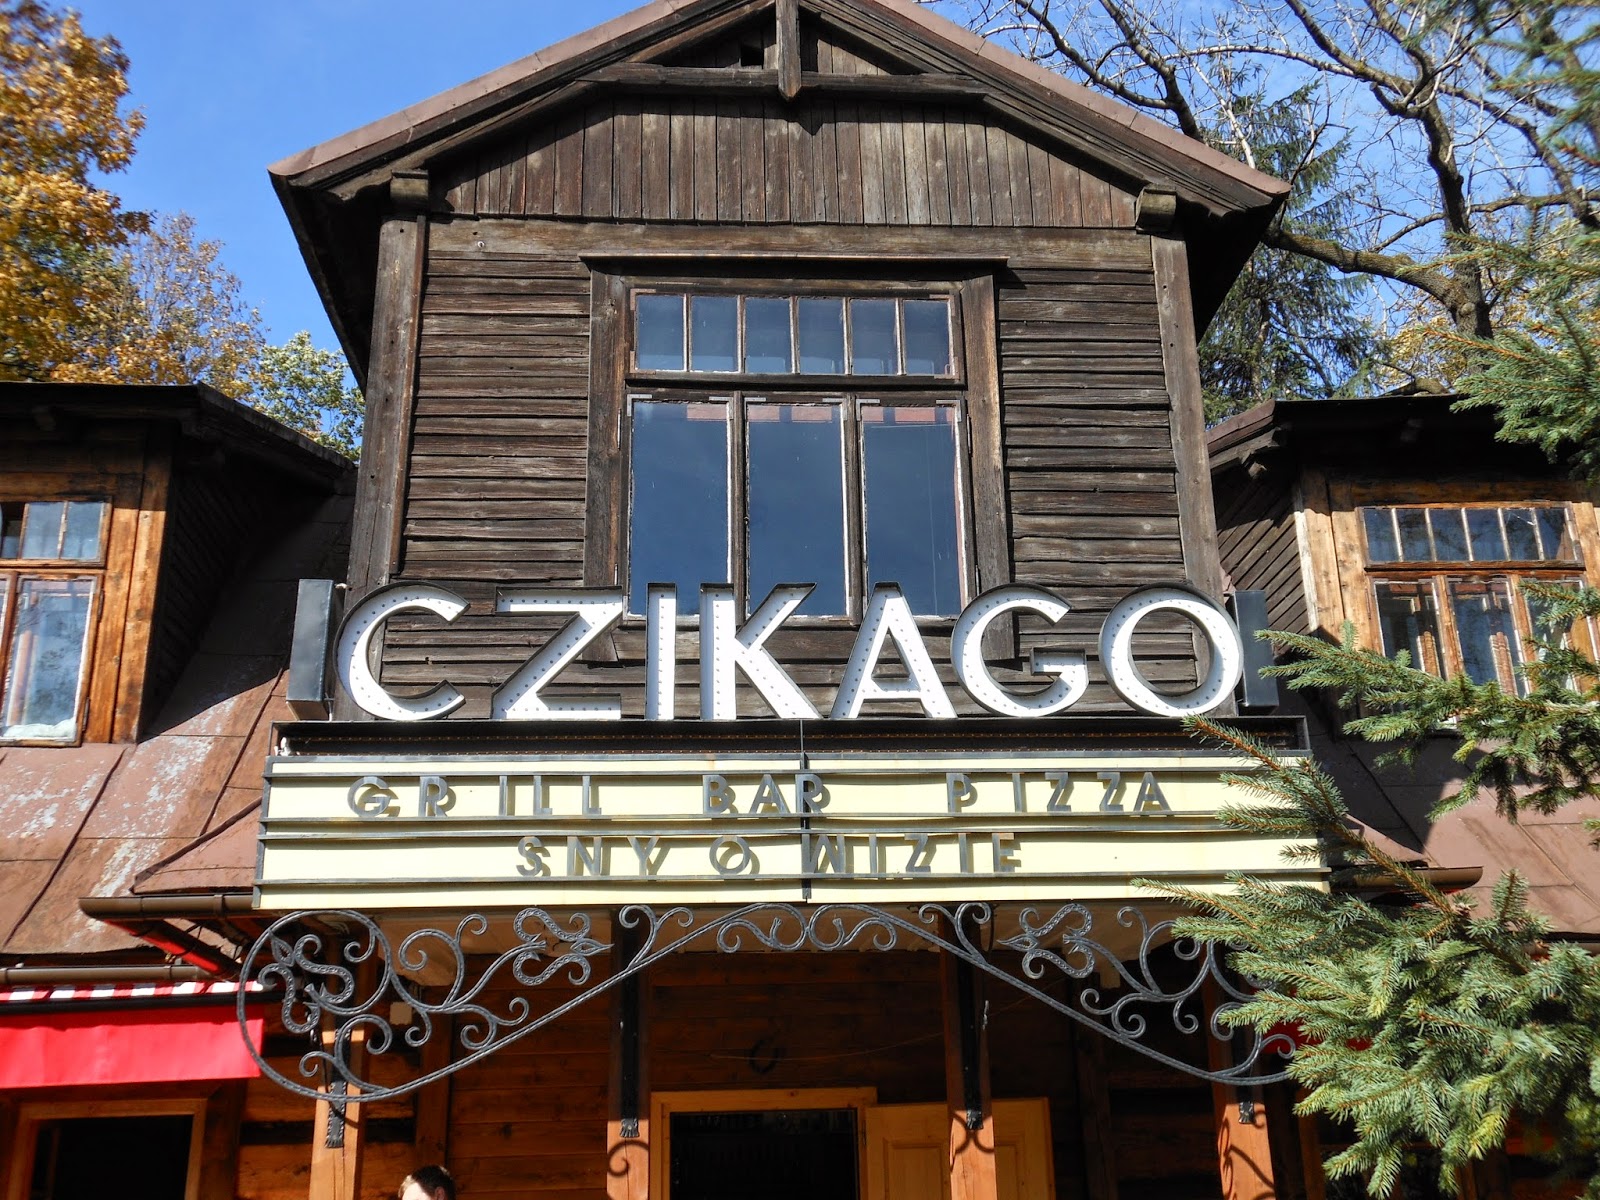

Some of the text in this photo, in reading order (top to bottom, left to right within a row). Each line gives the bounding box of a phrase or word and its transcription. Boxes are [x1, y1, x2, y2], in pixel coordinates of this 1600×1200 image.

[334, 581, 1244, 720] CZIKAGO
[347, 771, 1172, 817] GRILL BAR PIZZA
[516, 835, 661, 877] SNY
